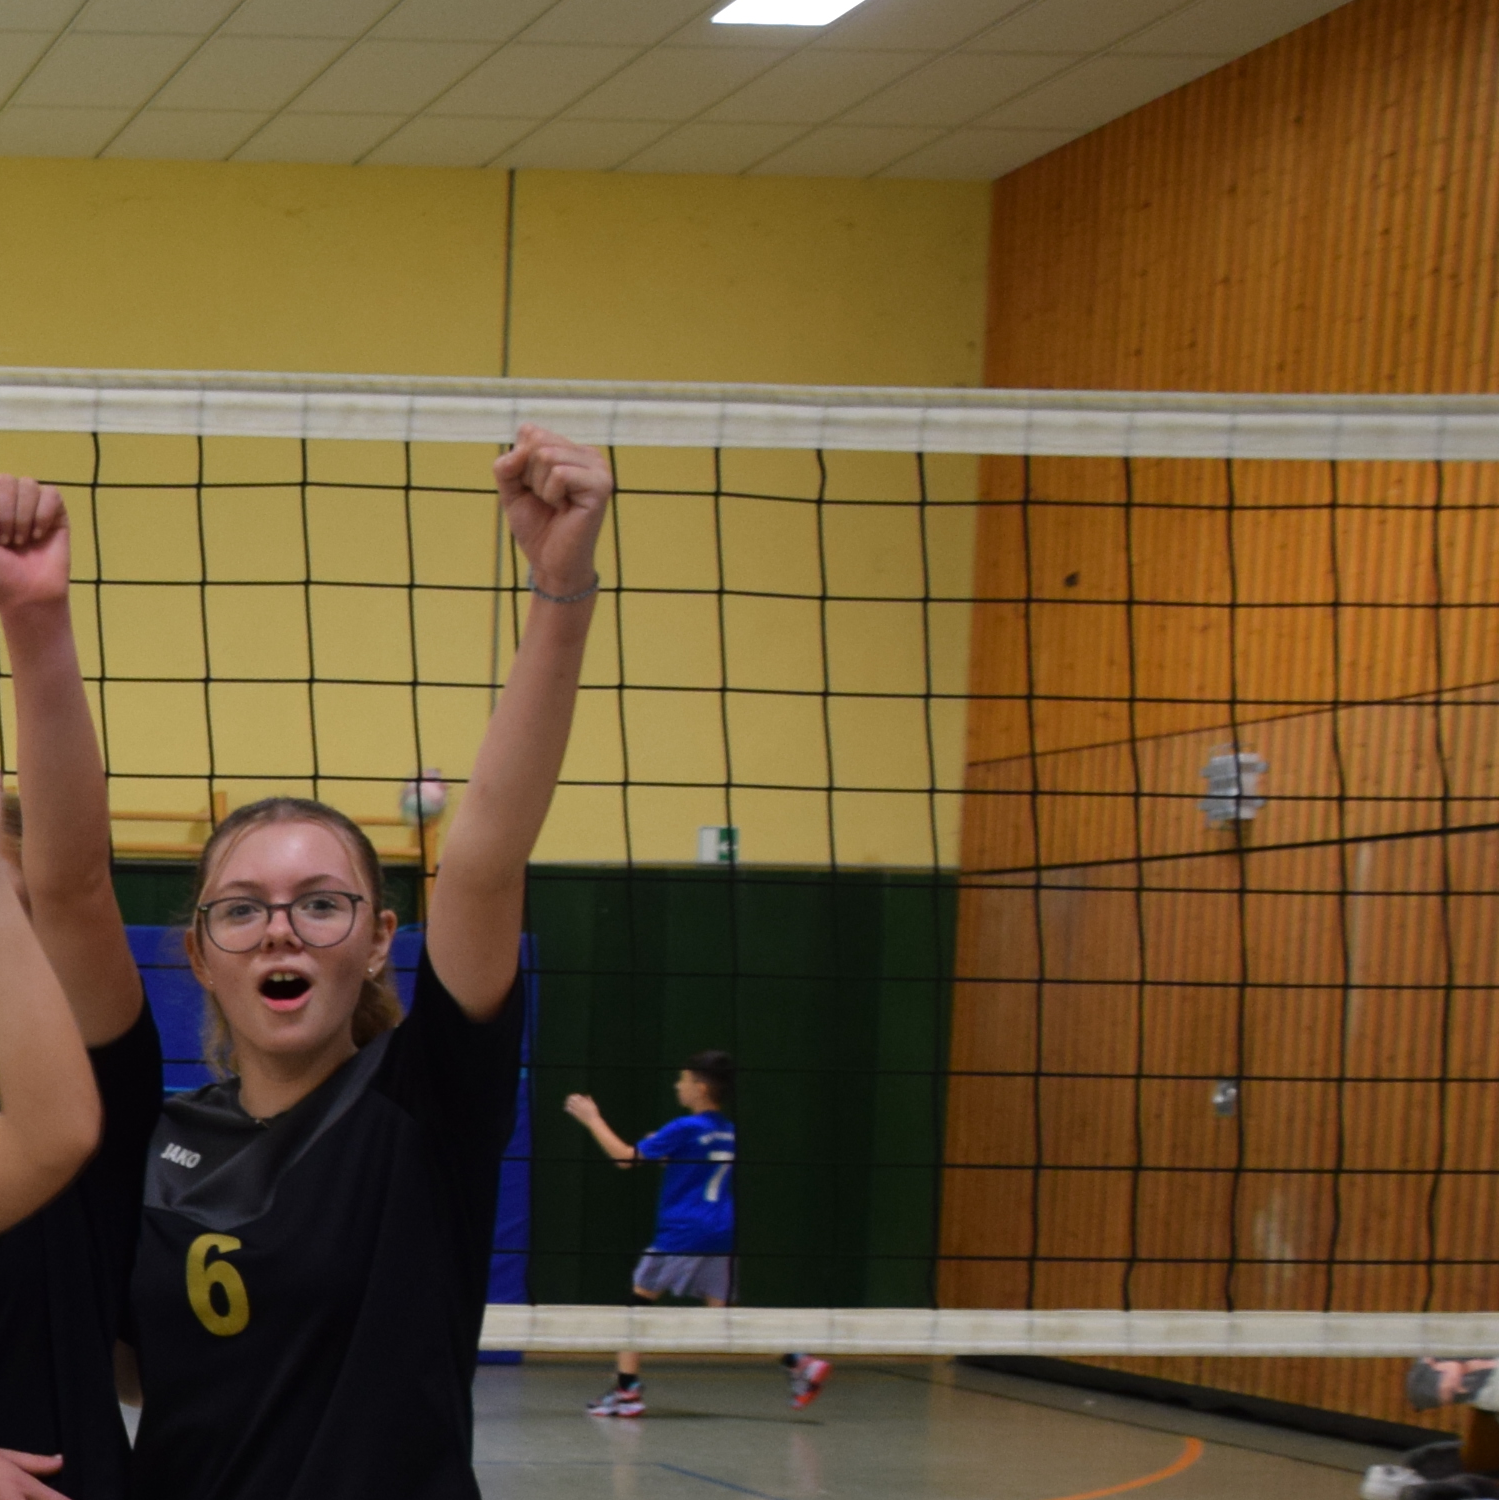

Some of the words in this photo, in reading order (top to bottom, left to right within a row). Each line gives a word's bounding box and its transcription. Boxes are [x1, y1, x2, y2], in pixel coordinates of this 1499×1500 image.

[160, 1142, 202, 1169] JAKO
[705, 1151, 735, 1202] 7
[185, 1233, 251, 1337] 6
